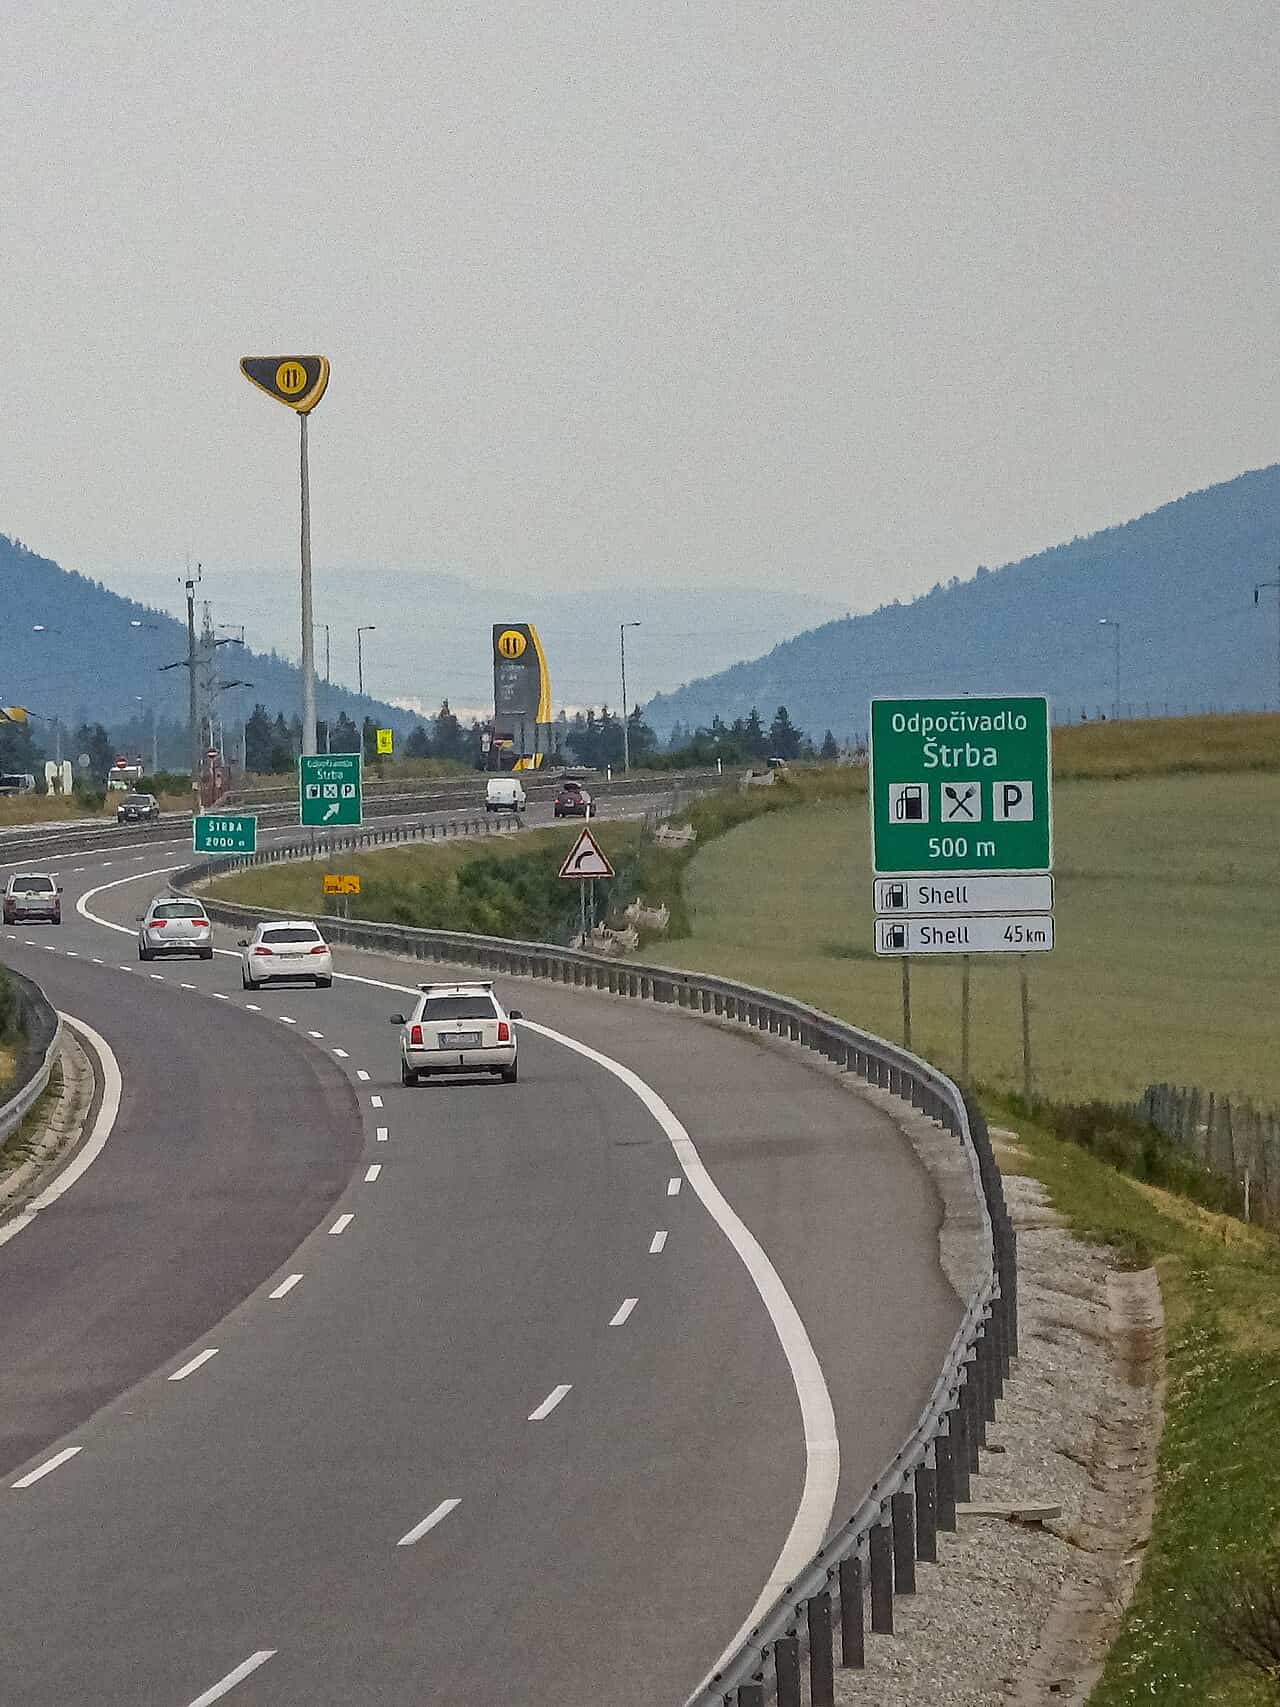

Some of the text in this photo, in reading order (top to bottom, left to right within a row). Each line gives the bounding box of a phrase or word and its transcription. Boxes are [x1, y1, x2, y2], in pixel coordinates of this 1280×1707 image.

[891, 711, 1027, 736] Odpočívadlo
[922, 737, 998, 768] Štrba
[344, 785, 352, 797] P
[1003, 784, 1023, 818] P
[205, 837, 234, 847] 2000
[928, 837, 996, 858] 500 m
[919, 885, 968, 904] Shell
[920, 927, 969, 945] Shell
